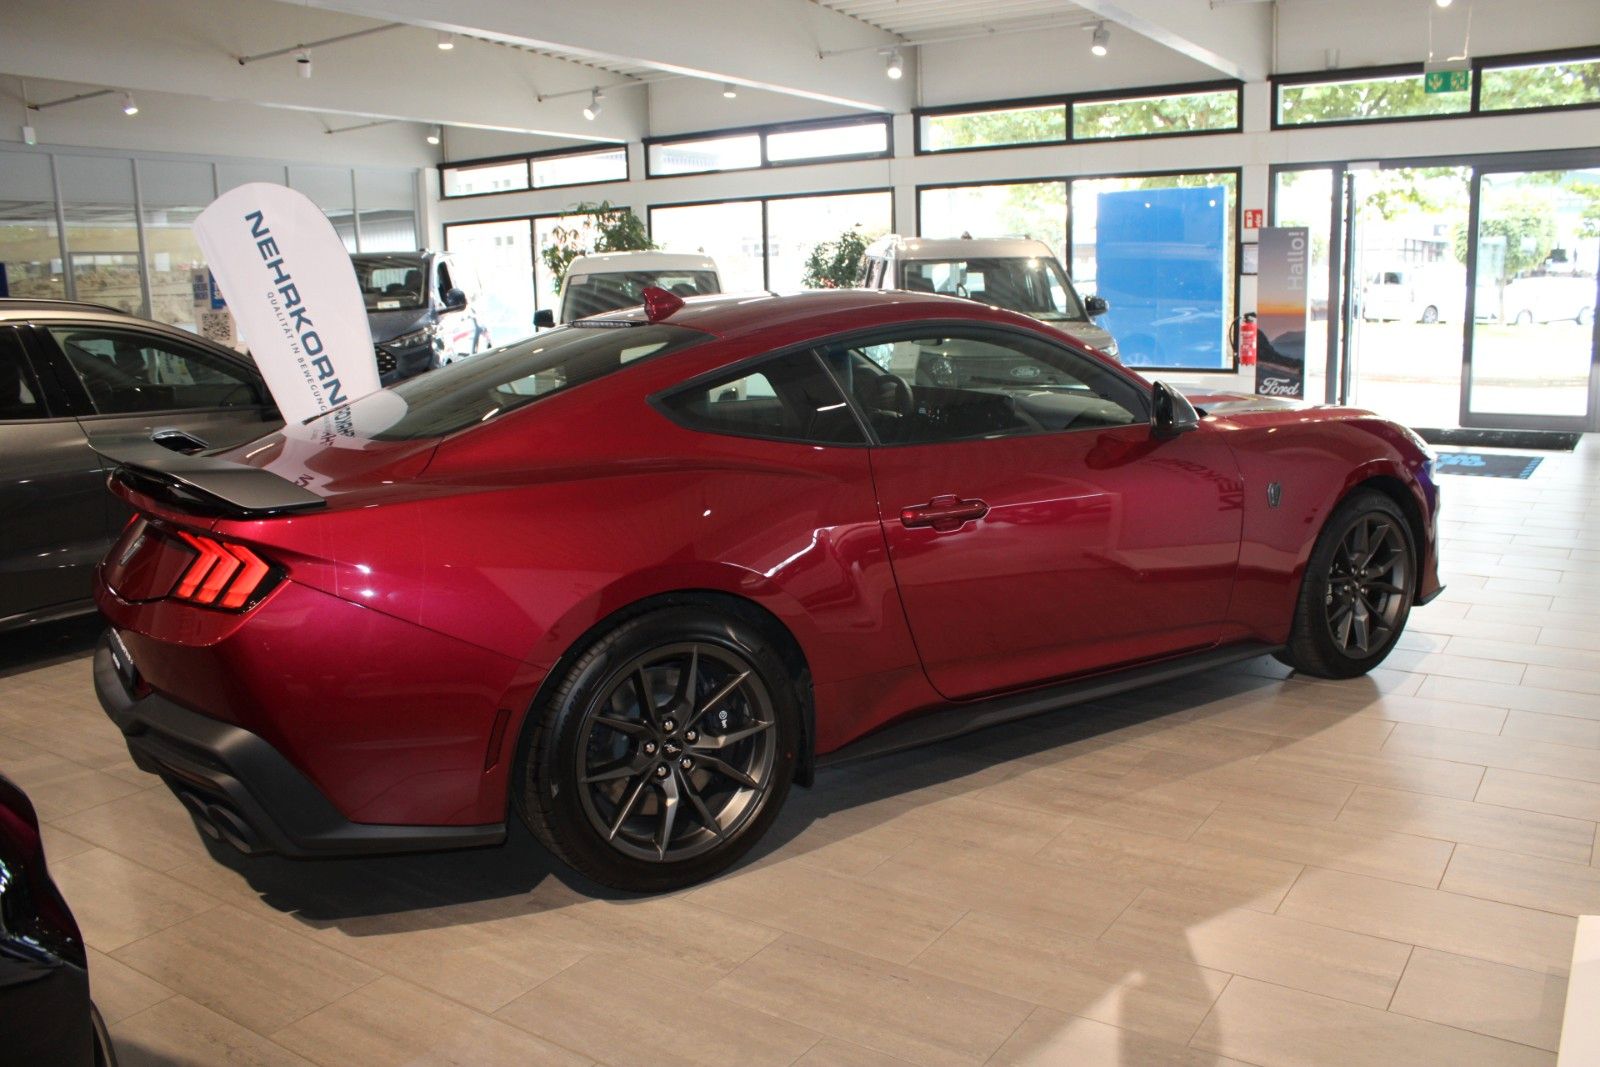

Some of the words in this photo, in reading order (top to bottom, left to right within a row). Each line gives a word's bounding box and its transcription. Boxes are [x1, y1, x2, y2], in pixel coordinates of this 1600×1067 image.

[1287, 231, 1304, 290] Hallo!
[245, 210, 348, 406] NEHRKORN
[267, 291, 294, 341] QUALITÄT
[290, 342, 300, 354] IN
[297, 357, 328, 411] BEWEGUNG
[1259, 377, 1300, 395] Ford
